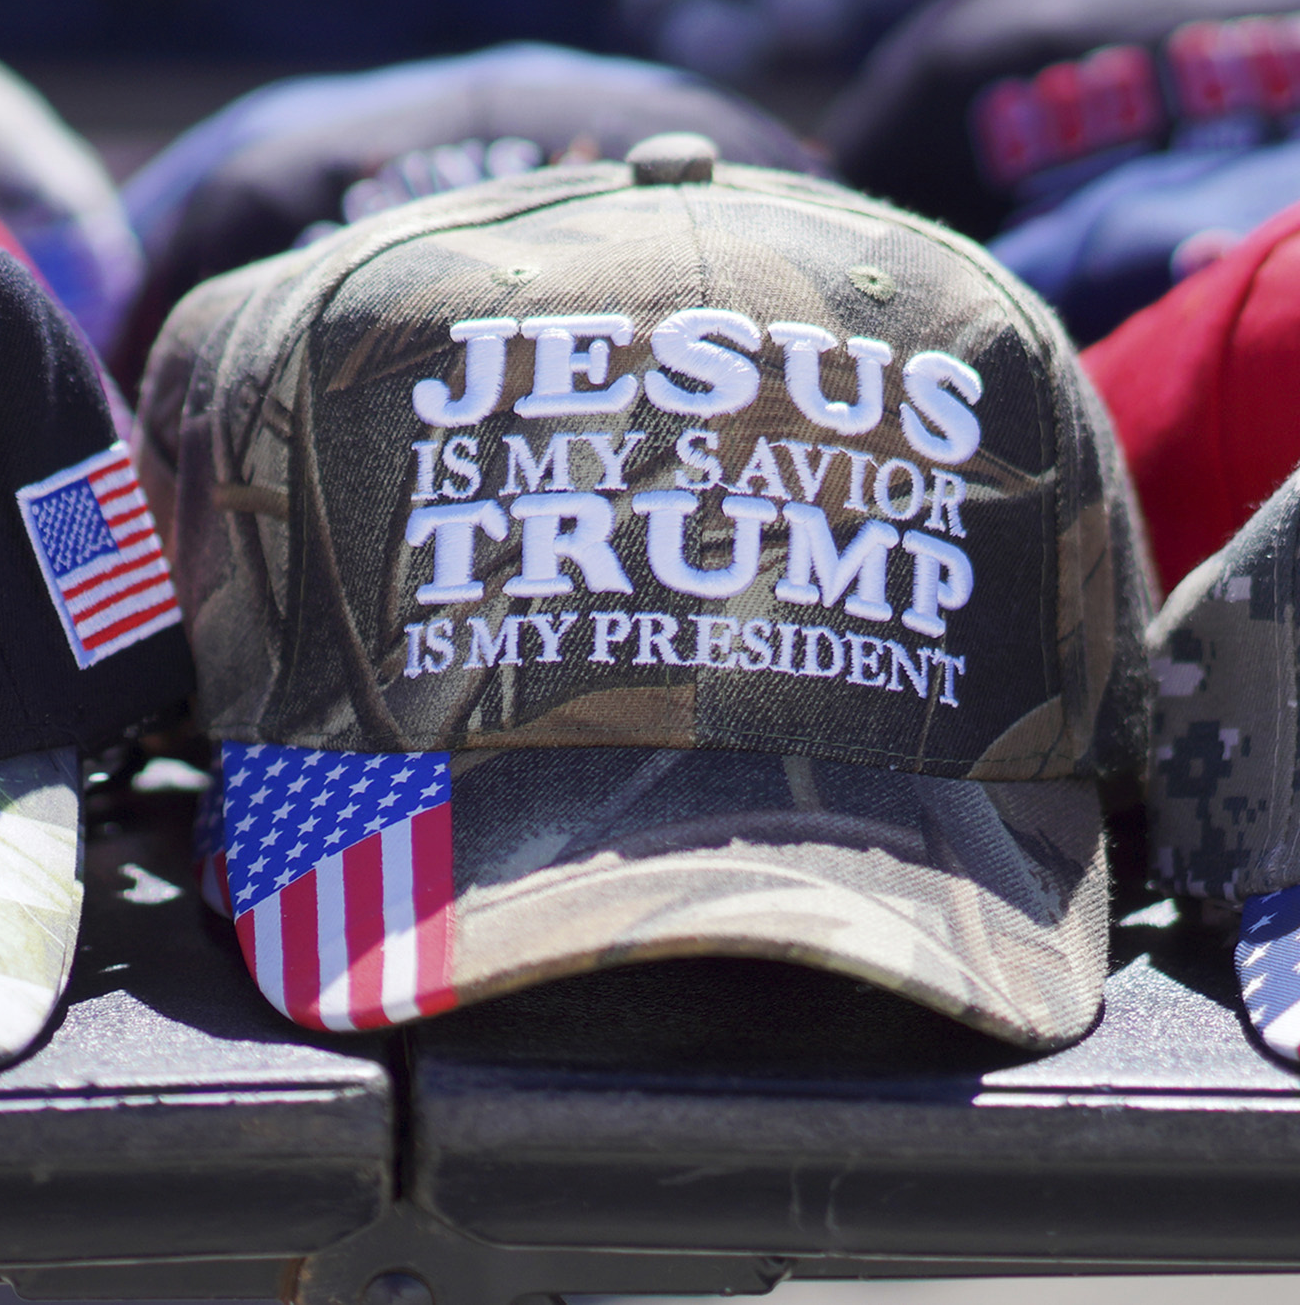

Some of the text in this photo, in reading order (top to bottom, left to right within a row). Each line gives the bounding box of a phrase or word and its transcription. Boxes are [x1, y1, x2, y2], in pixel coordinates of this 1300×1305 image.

[412, 307, 983, 465] JESUS
[411, 429, 968, 538] IS MY SAVIOR
[406, 489, 974, 637] TRUMP
[403, 610, 966, 708] IS MY PRESIDENT
